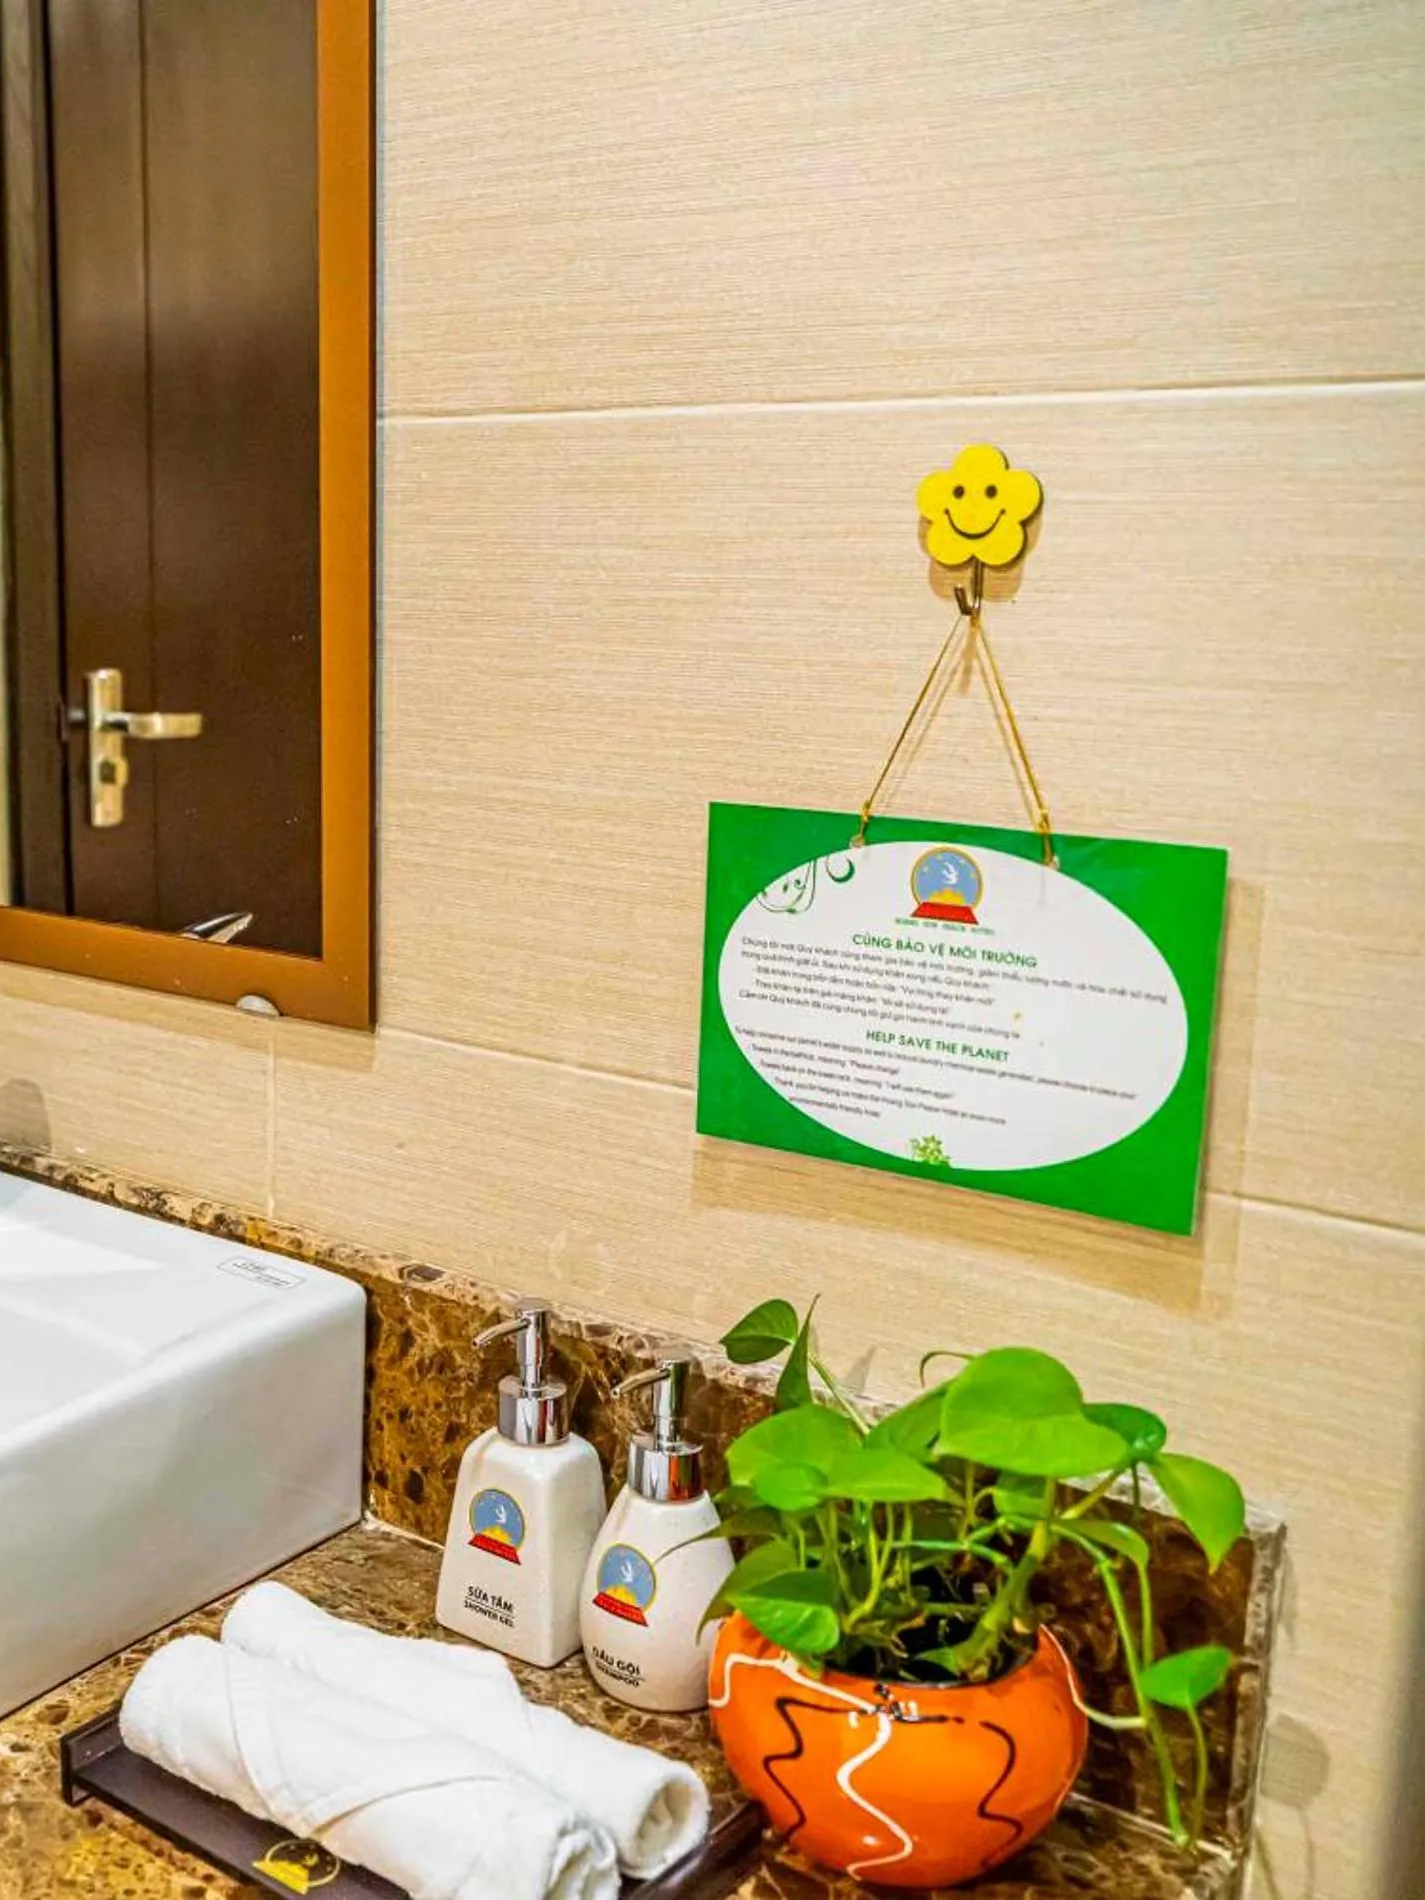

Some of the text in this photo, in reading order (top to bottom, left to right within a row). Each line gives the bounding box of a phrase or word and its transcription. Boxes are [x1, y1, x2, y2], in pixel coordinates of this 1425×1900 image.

[866, 1028, 895, 1044] HELP
[898, 1034, 931, 1050] SAVE
[936, 1040, 957, 1054] THE
[961, 1044, 1010, 1063] PLANET
